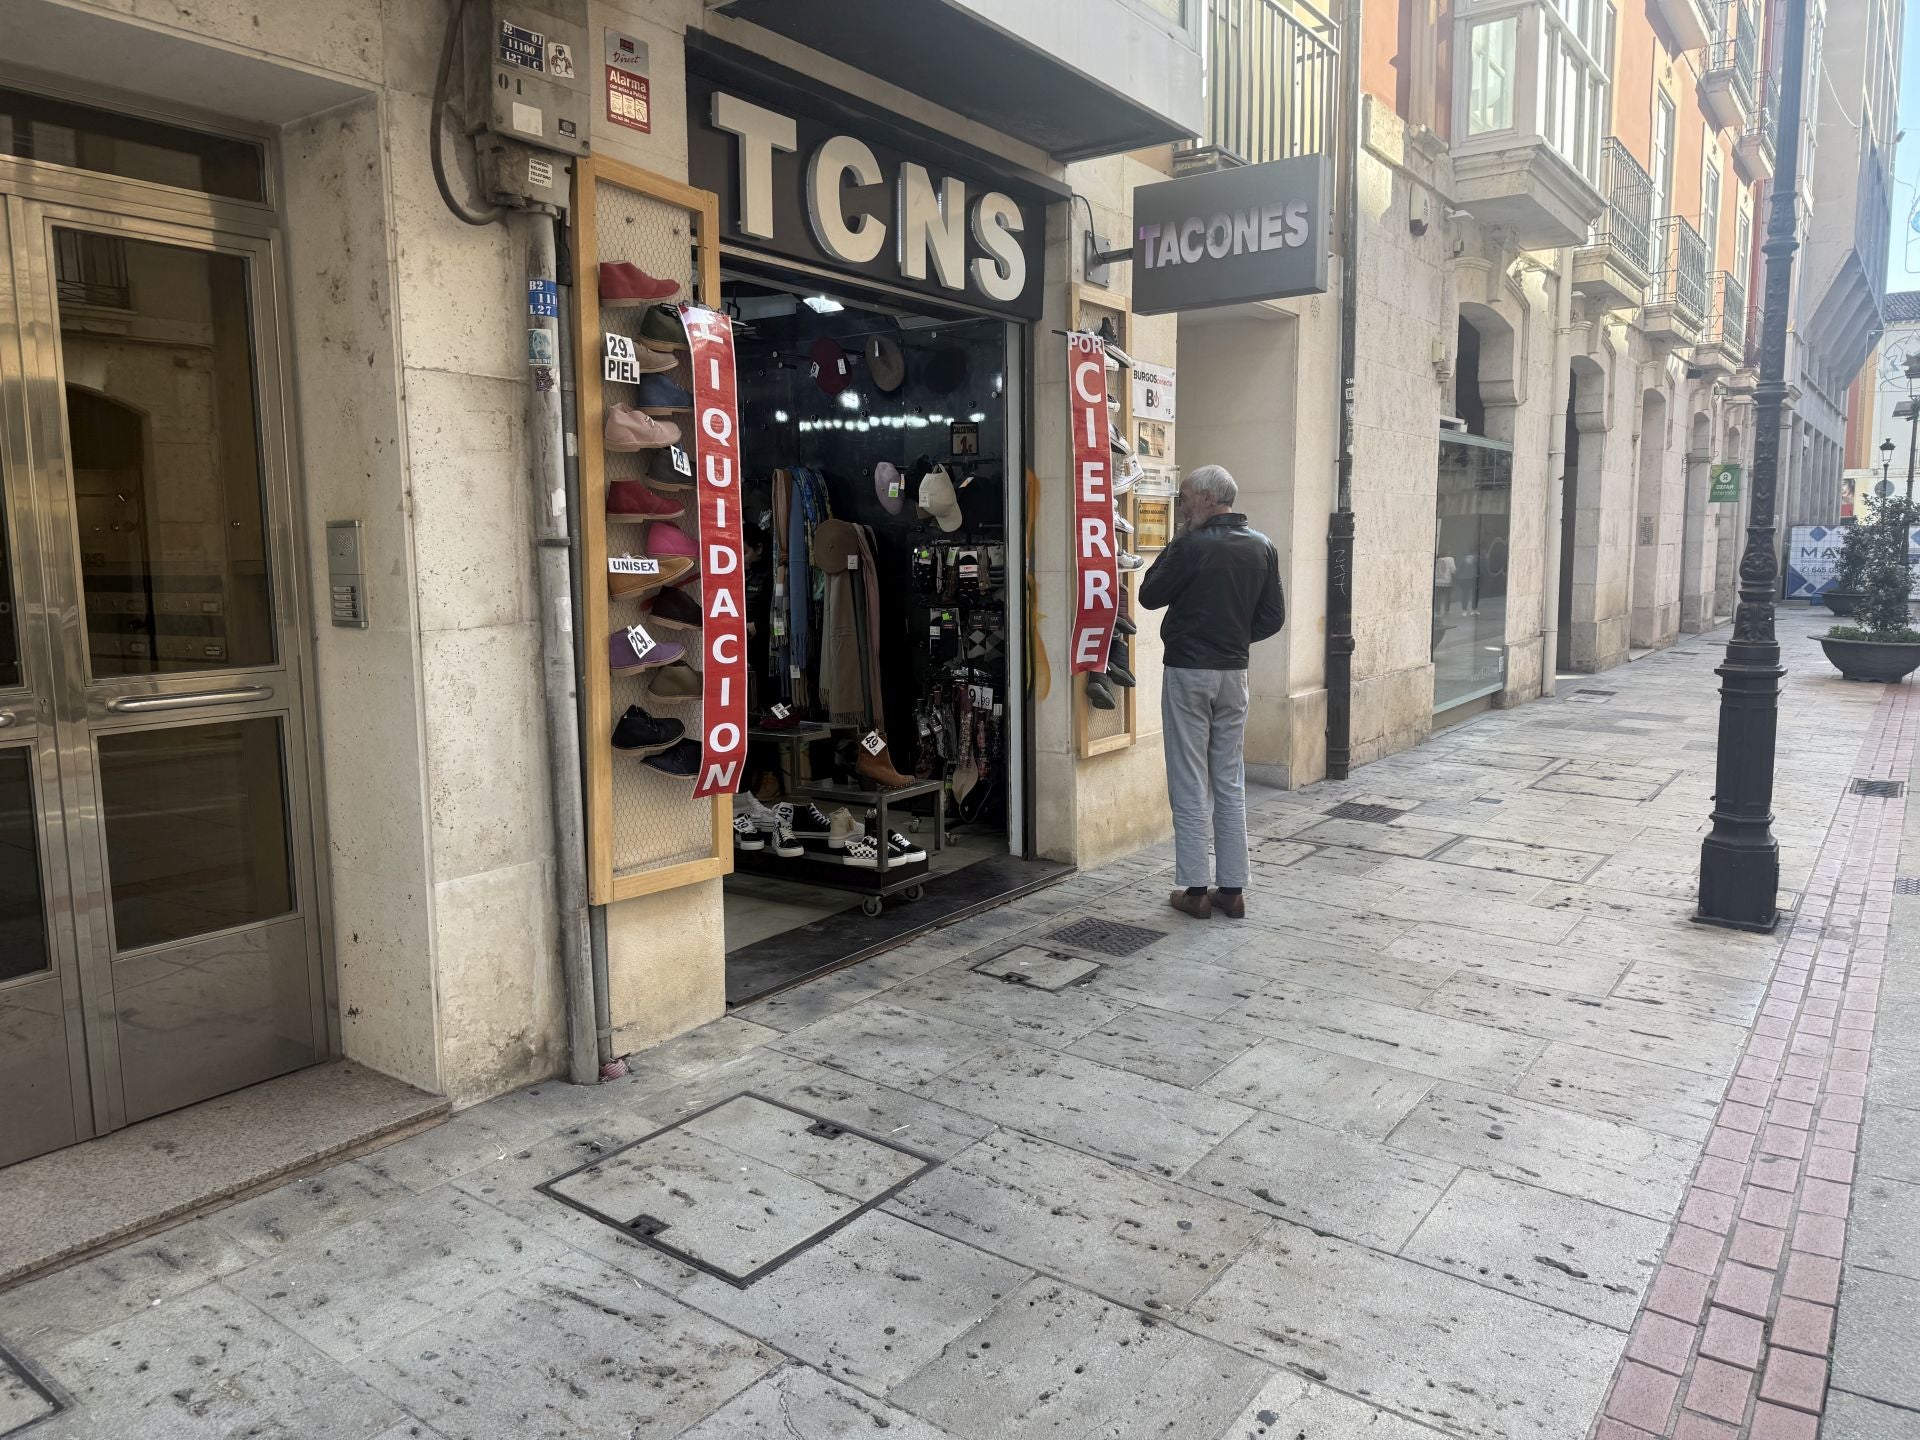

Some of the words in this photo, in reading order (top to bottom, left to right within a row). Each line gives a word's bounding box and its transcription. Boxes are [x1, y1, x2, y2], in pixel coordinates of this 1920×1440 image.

[609, 70, 647, 94] Alarma
[711, 91, 1026, 301] TCNS
[1139, 198, 1309, 269] TACONES
[529, 280, 544, 291] B2
[538, 293, 558, 305] 111
[1067, 333, 1104, 355] POR
[607, 359, 638, 383] PIEL
[1075, 361, 1114, 664] CIERRE
